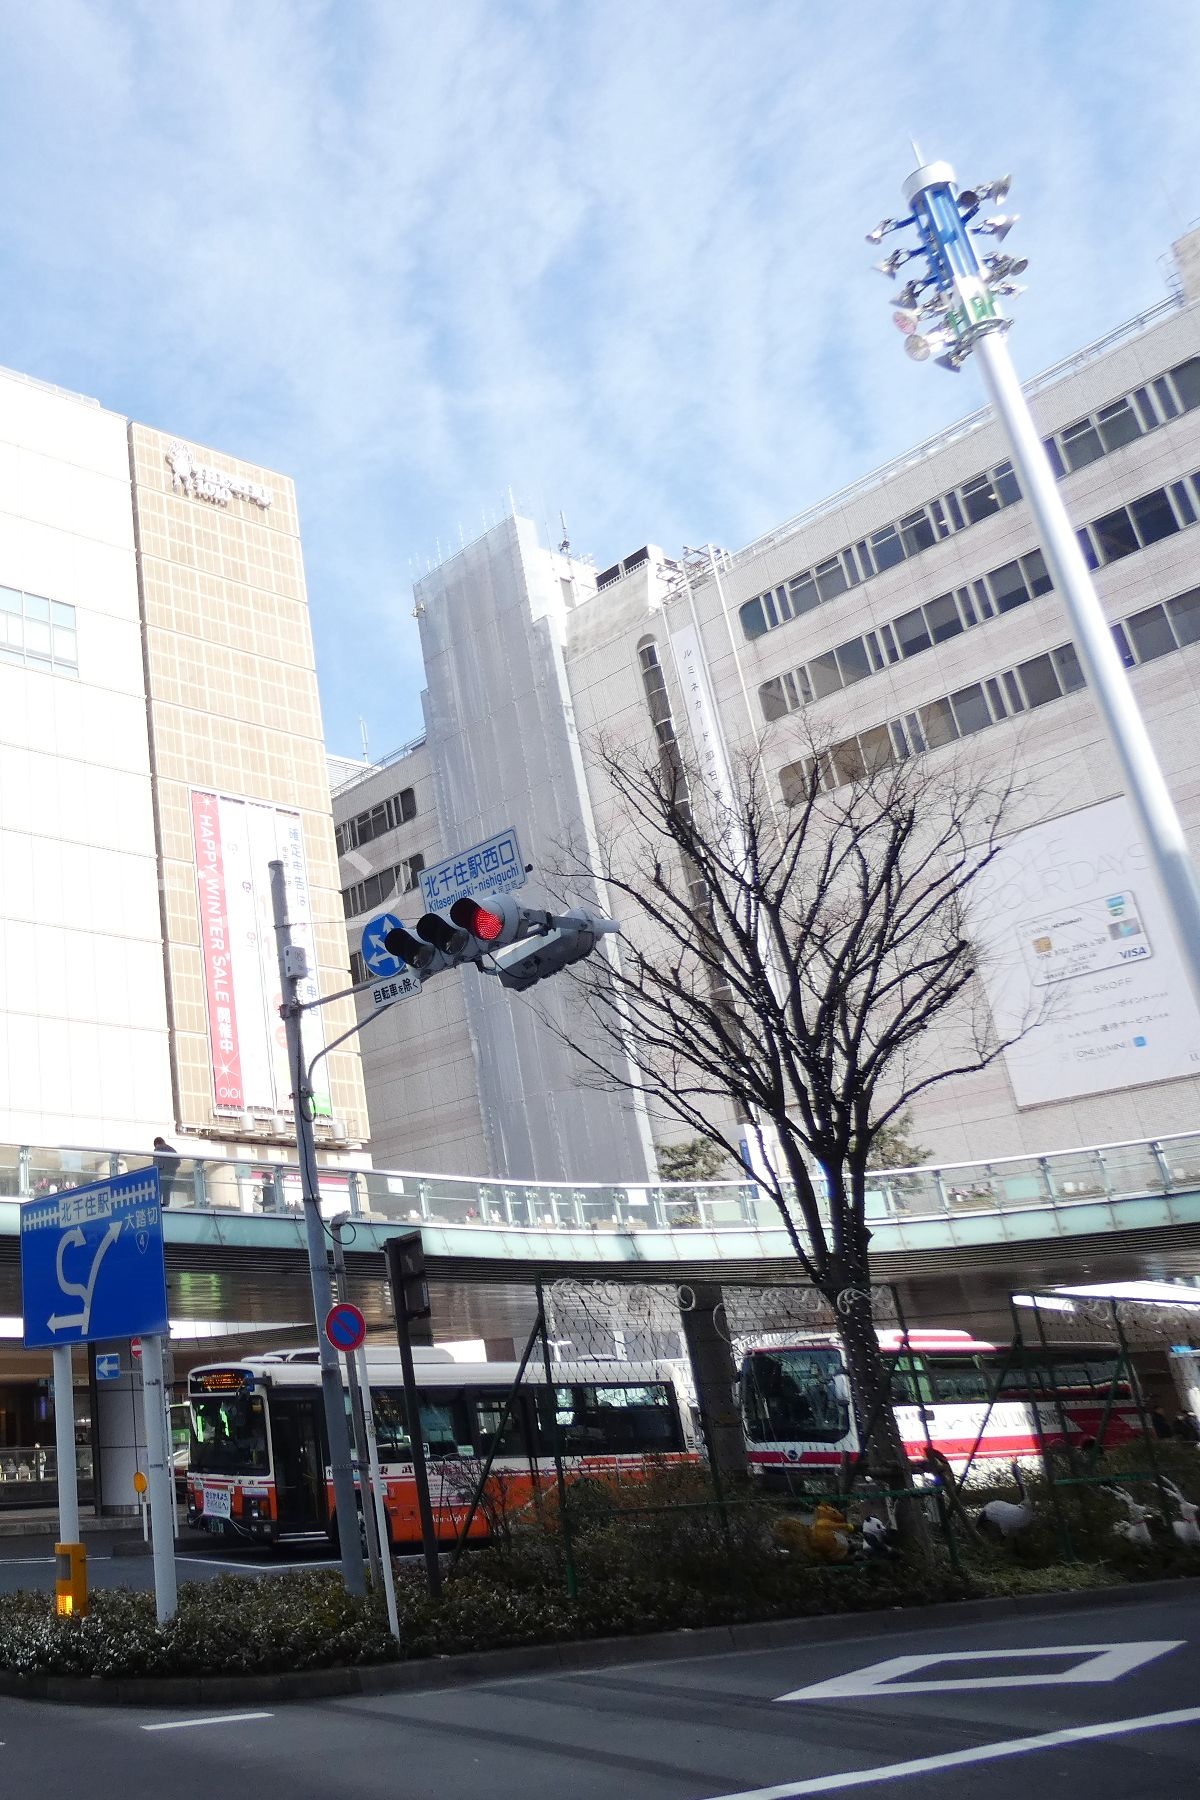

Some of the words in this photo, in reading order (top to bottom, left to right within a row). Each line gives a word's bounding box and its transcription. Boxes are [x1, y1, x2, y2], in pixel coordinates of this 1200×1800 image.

[199, 814, 219, 874] HAPPY
[423, 838, 516, 899] 北千住駅西口
[205, 877, 225, 951] WINTER
[1118, 946, 1147, 960] VISA
[211, 956, 230, 1003] SALE
[372, 979, 419, 1004] 自転車を除く
[60, 1191, 110, 1222] 北千住駅
